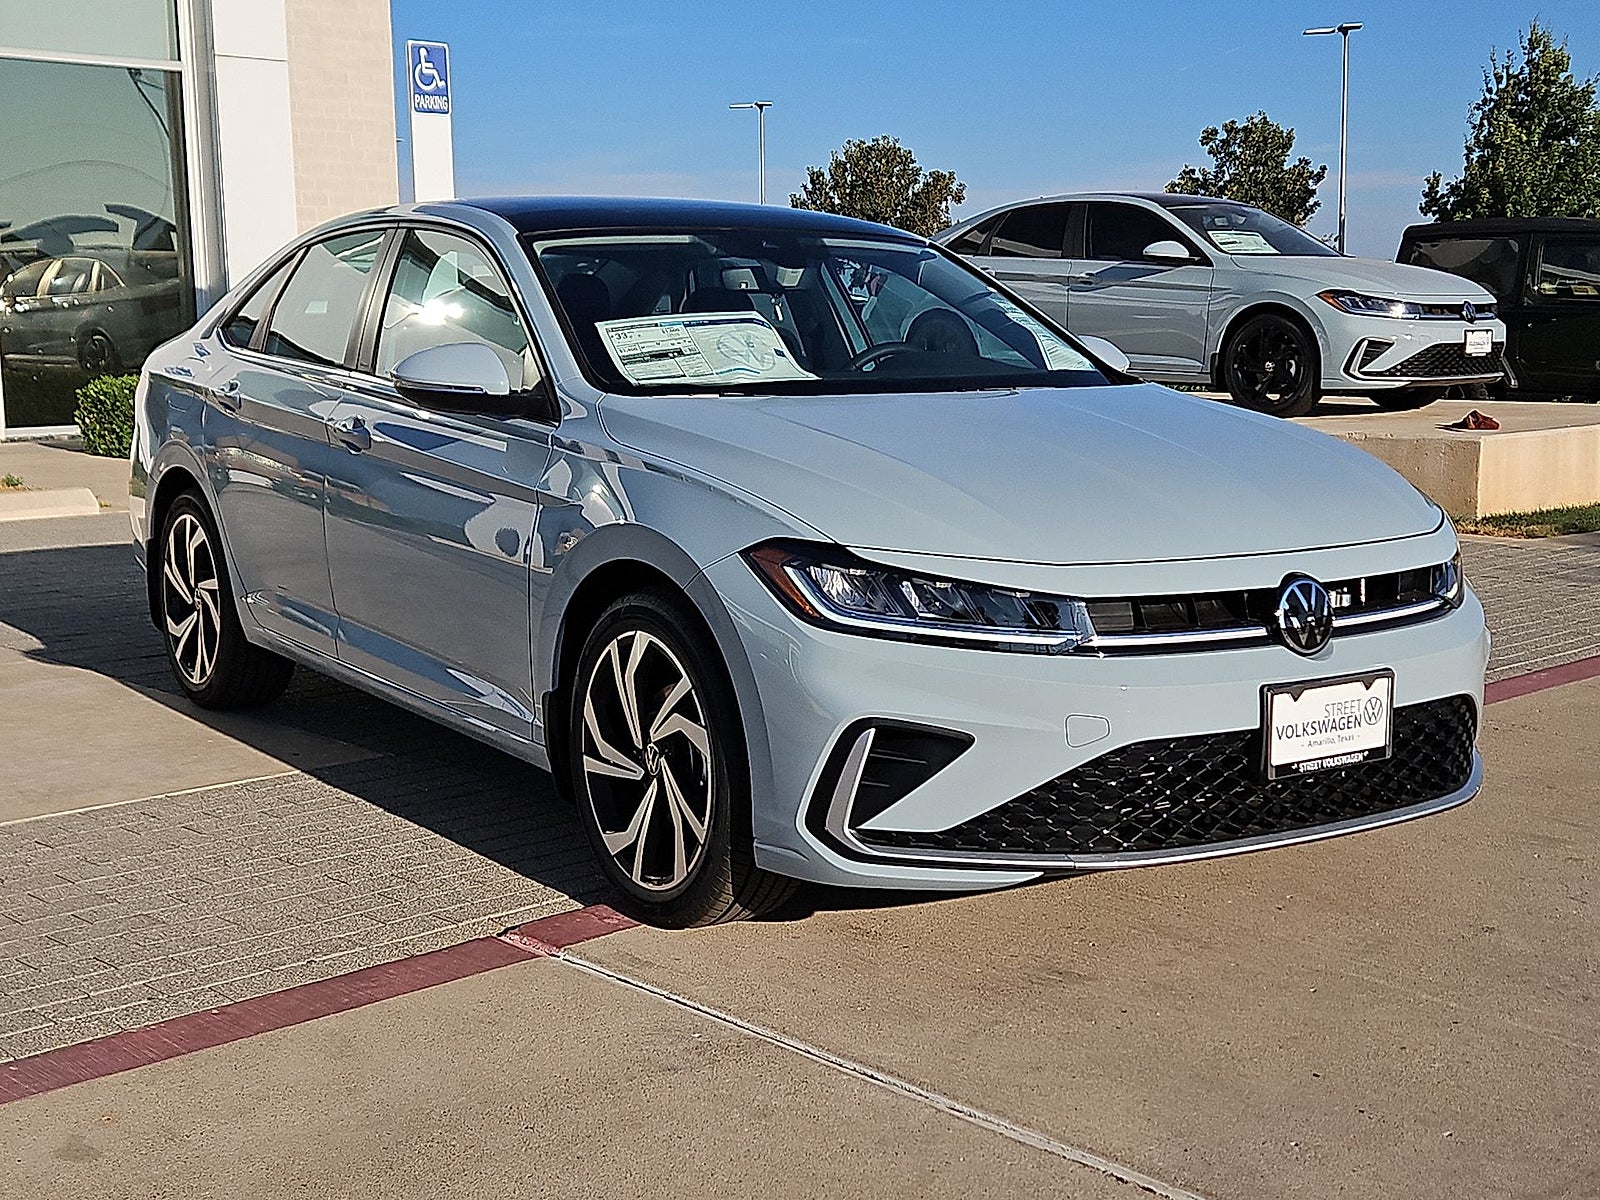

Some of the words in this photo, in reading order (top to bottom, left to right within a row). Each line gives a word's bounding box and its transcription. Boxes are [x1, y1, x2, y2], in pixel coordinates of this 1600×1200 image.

[414, 94, 448, 110] PARKING
[1324, 699, 1362, 718] STREET
[1276, 714, 1362, 740] VOLKSWAGEN
[1337, 734, 1355, 744] Texas
[1299, 760, 1322, 773] STREET
